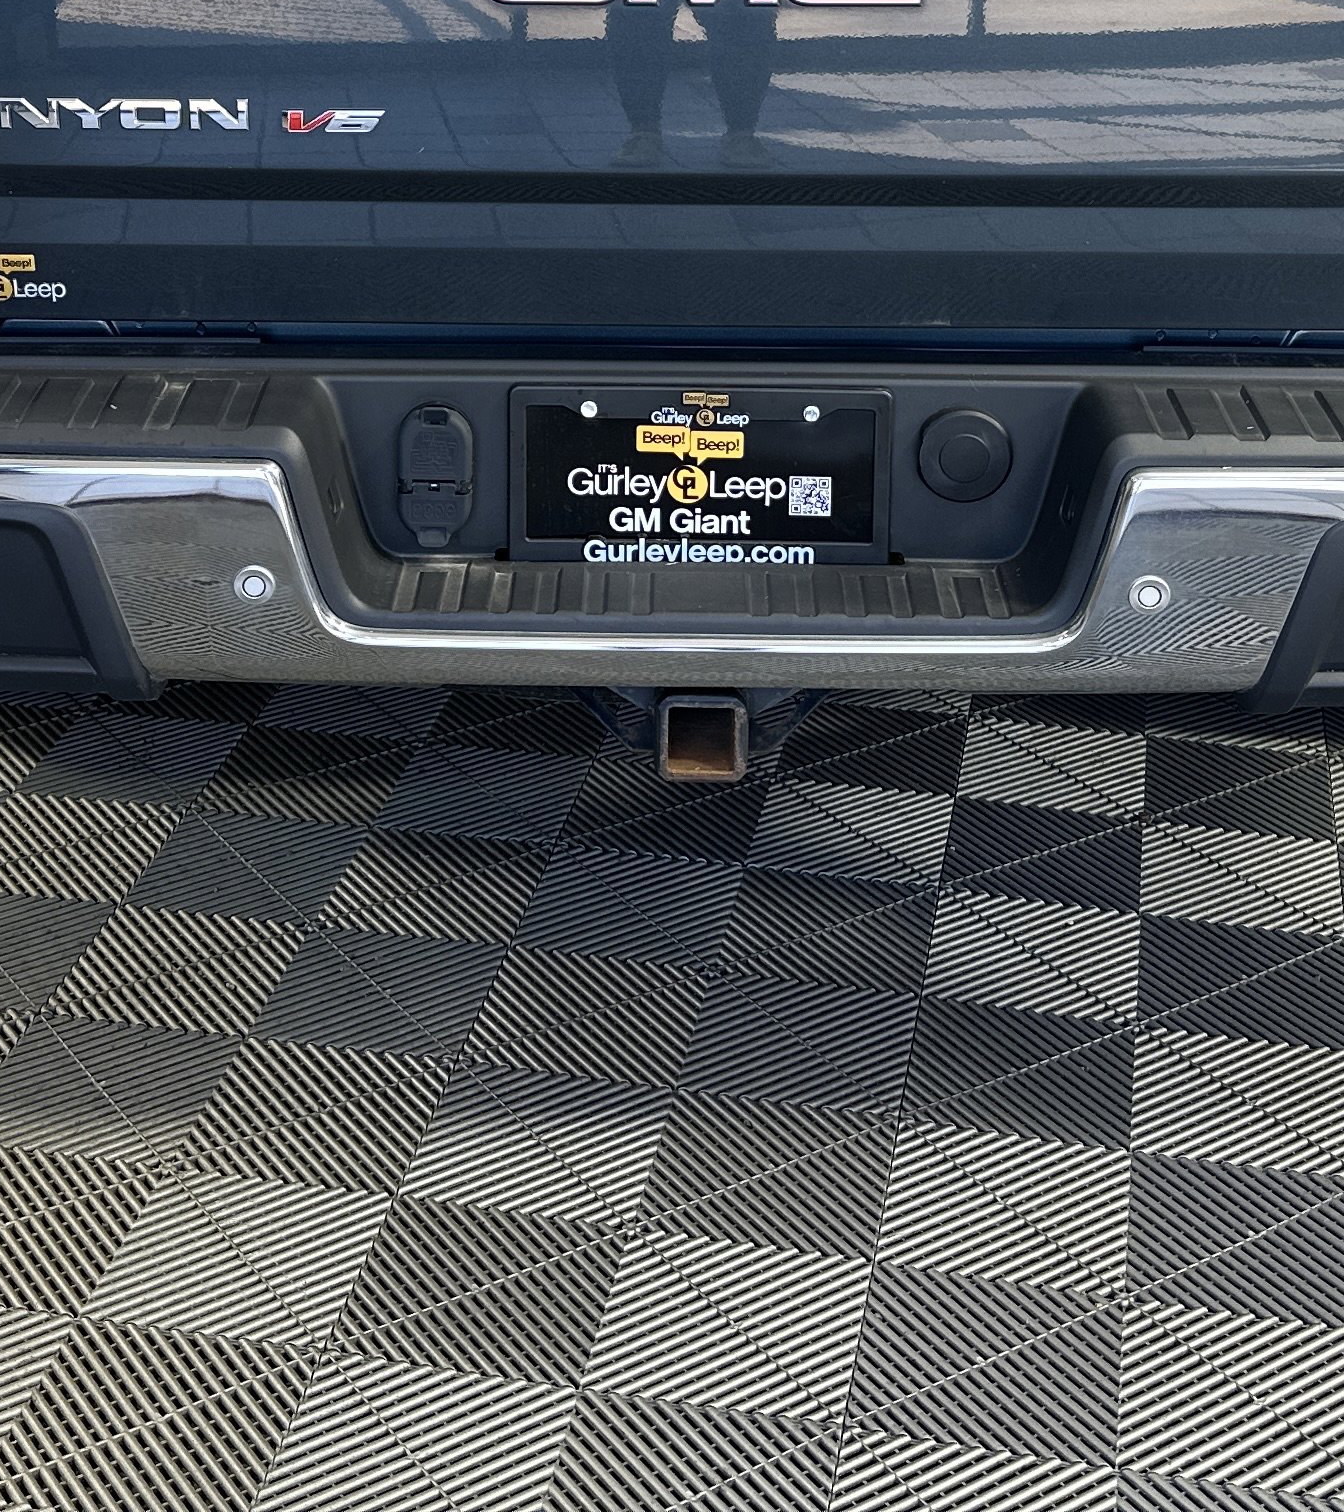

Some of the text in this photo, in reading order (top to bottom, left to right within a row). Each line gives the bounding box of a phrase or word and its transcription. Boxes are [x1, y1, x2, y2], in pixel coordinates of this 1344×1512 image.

[281, 109, 386, 133] V6
[12, 278, 67, 303] Leep
[650, 410, 693, 428] Gurley
[716, 412, 750, 428] Leep
[642, 430, 686, 448] Beep!
[696, 437, 740, 455] Beep!
[567, 466, 668, 504] Gurley
[709, 470, 786, 506] Leep
[609, 507, 751, 534] GM Giant
[583, 539, 815, 565] Gurleyleep.com
